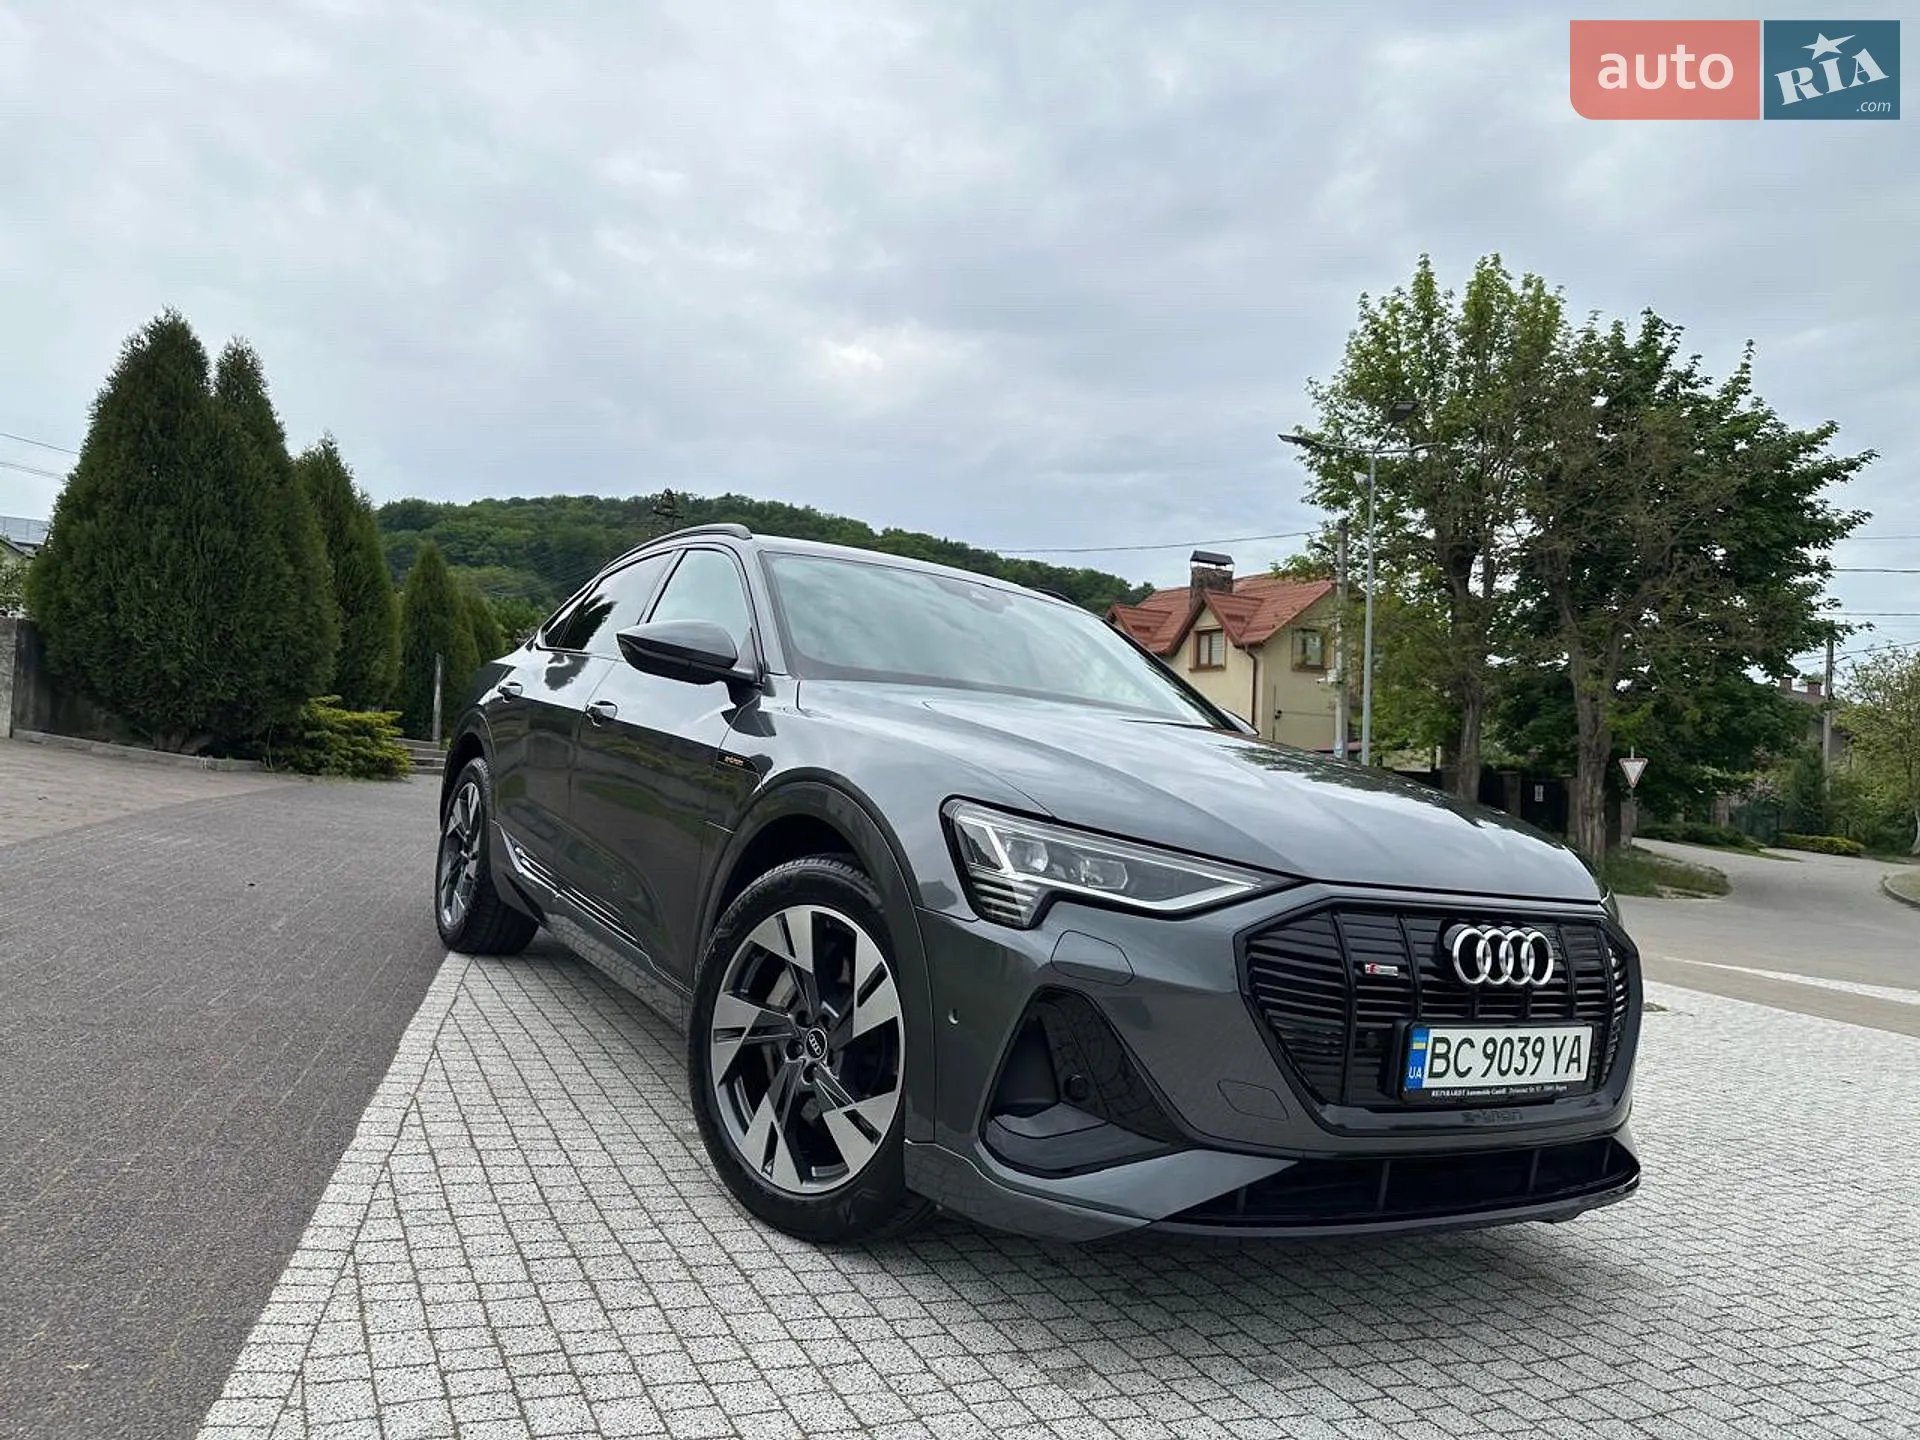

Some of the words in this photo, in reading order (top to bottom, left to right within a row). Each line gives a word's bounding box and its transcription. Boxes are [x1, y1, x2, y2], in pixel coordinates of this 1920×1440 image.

[1428, 1036, 1475, 1079] BC
[1481, 1036, 1545, 1078] 9039
[1552, 1035, 1582, 1075] YA
[1408, 1066, 1422, 1080] UA
